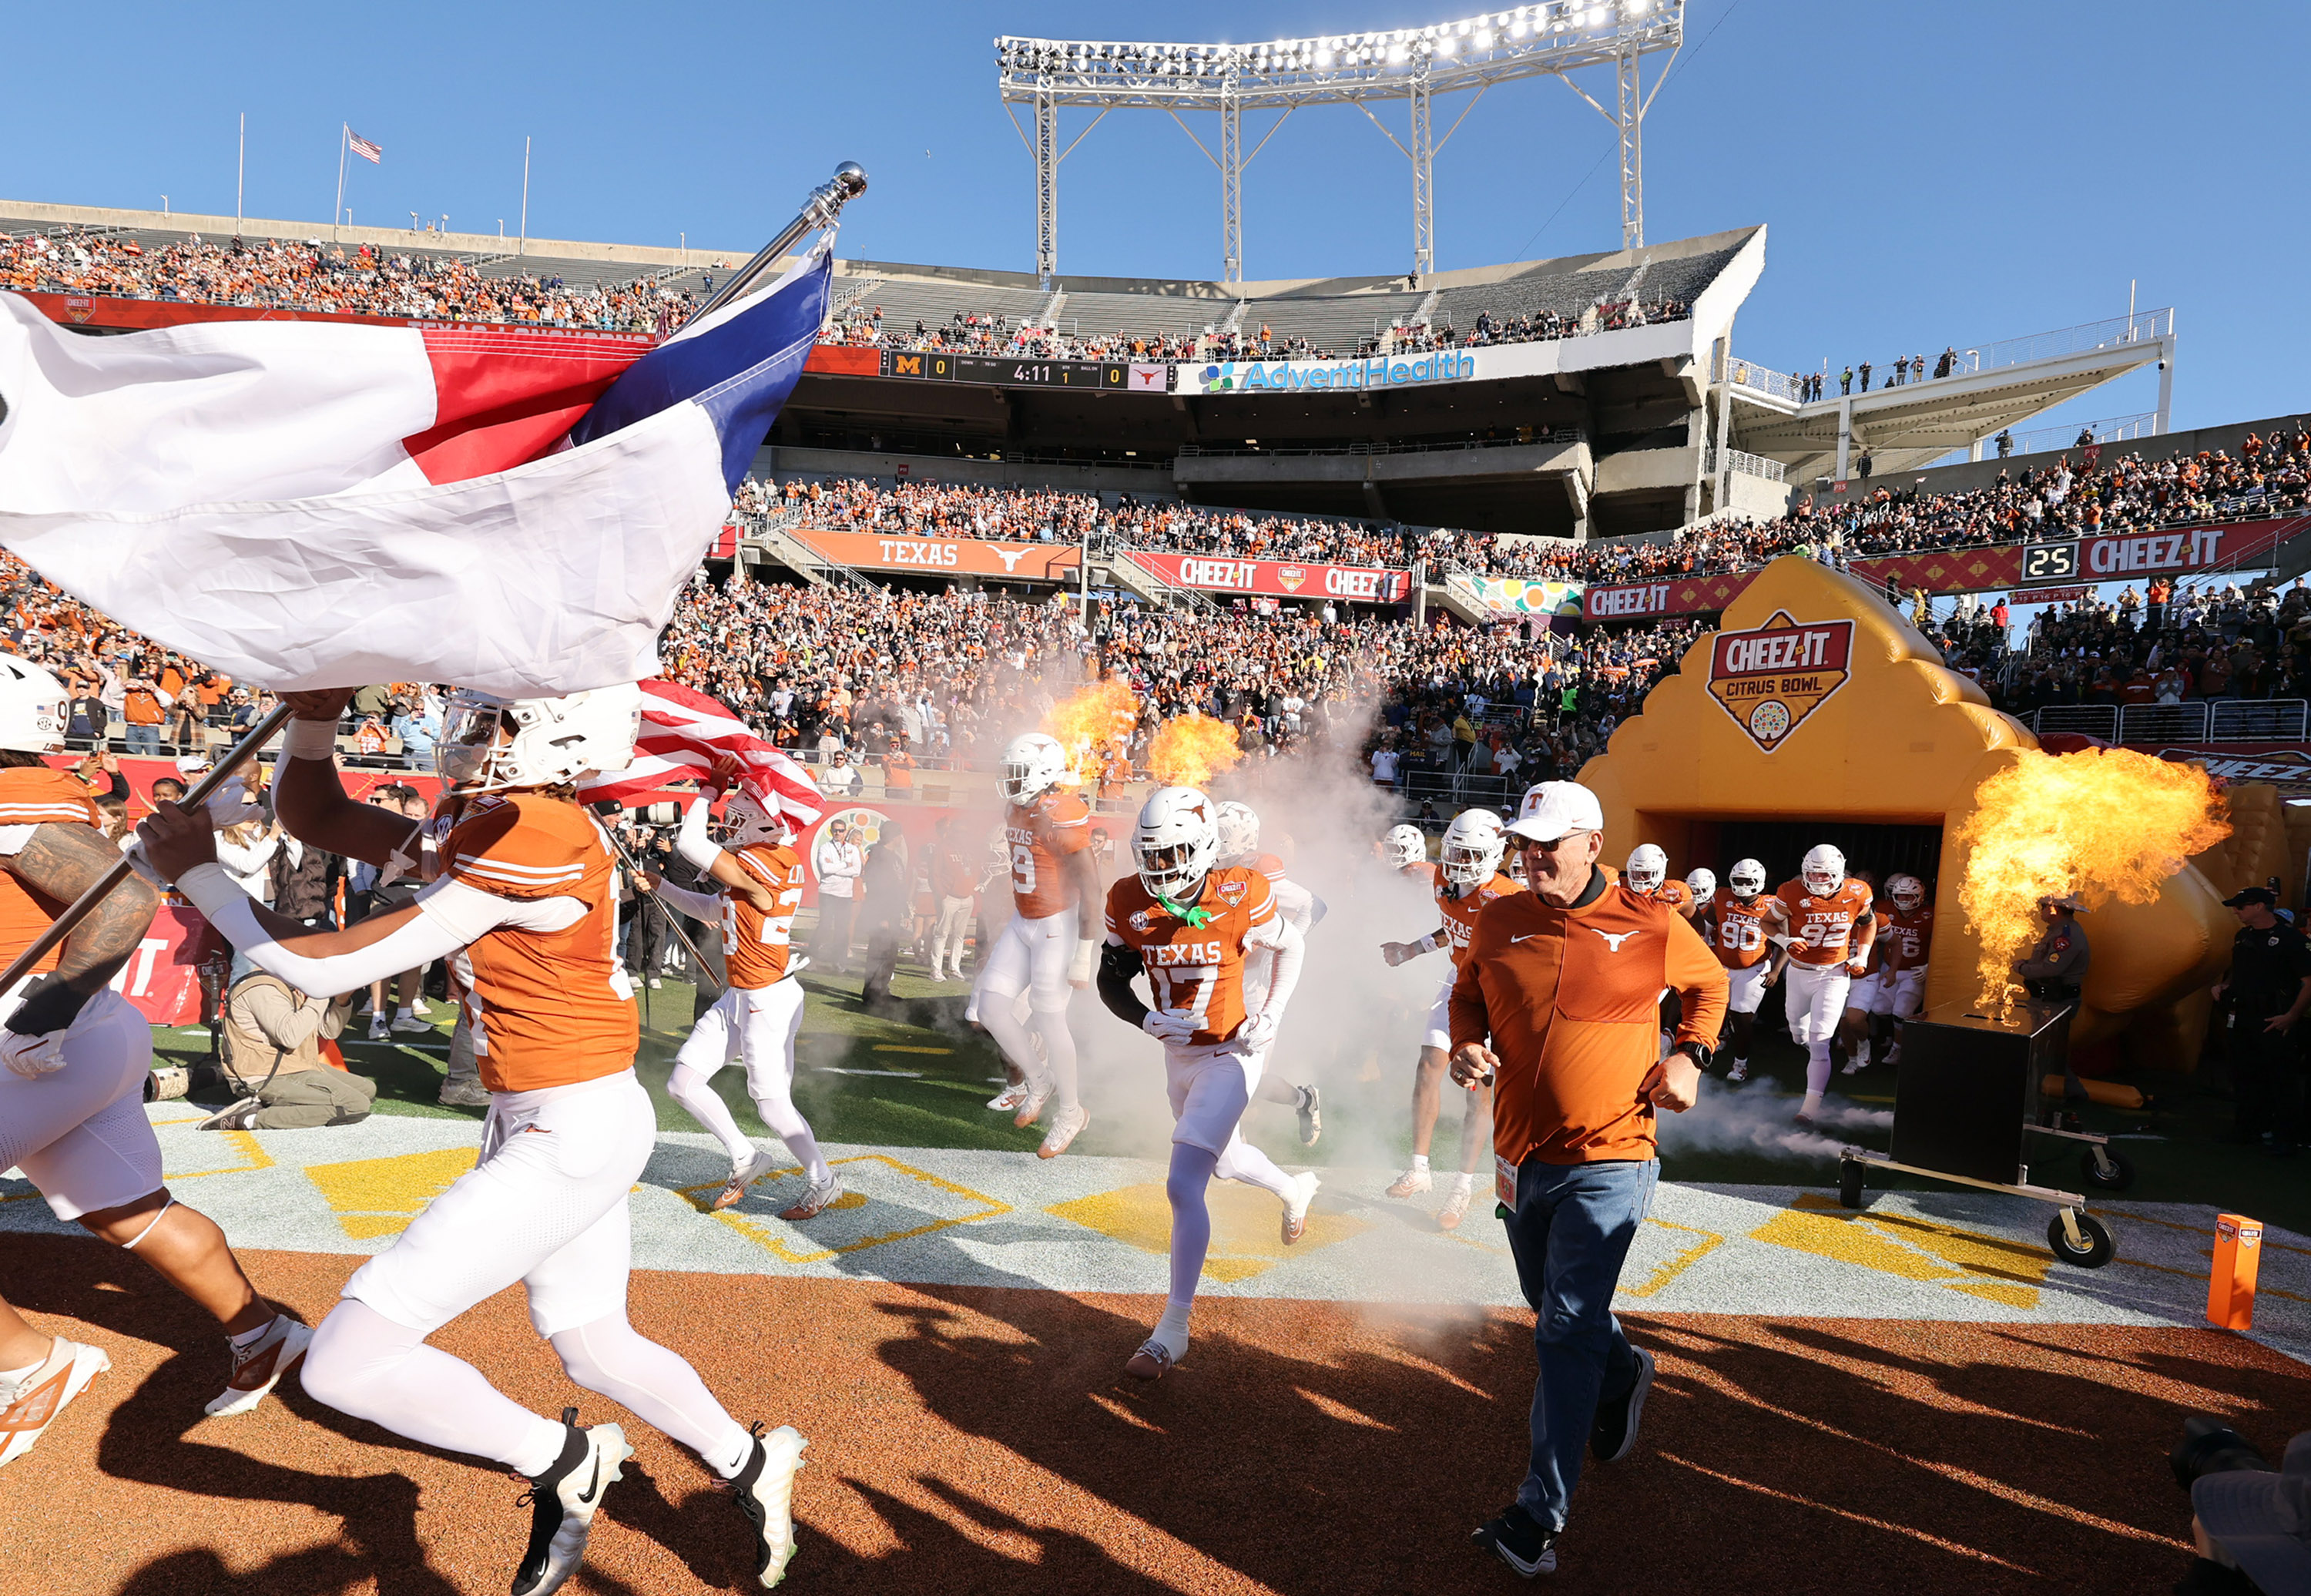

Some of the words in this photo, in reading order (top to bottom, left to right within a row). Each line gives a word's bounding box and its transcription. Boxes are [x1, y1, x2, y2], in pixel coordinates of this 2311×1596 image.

[896, 355, 921, 374] M
[936, 360, 945, 374] 0
[1014, 364, 1050, 382] 4:11
[1245, 350, 1475, 389] AdventHealth
[1063, 372, 1068, 384] 1
[1110, 369, 1119, 383] 0
[879, 540, 958, 566] TEXAS
[2029, 547, 2070, 576] 25
[1726, 679, 1776, 696] CITRUS
[1781, 676, 1823, 692] BOWL
[1528, 793, 1543, 810] T
[1012, 844, 1036, 894] 9
[1726, 912, 1761, 925] TEXAS
[1805, 910, 1850, 924] TEXAS
[1721, 920, 1761, 951] 90
[1799, 924, 1852, 948] 92
[1141, 940, 1222, 967] TEXAS
[1150, 964, 1219, 1031] 17
